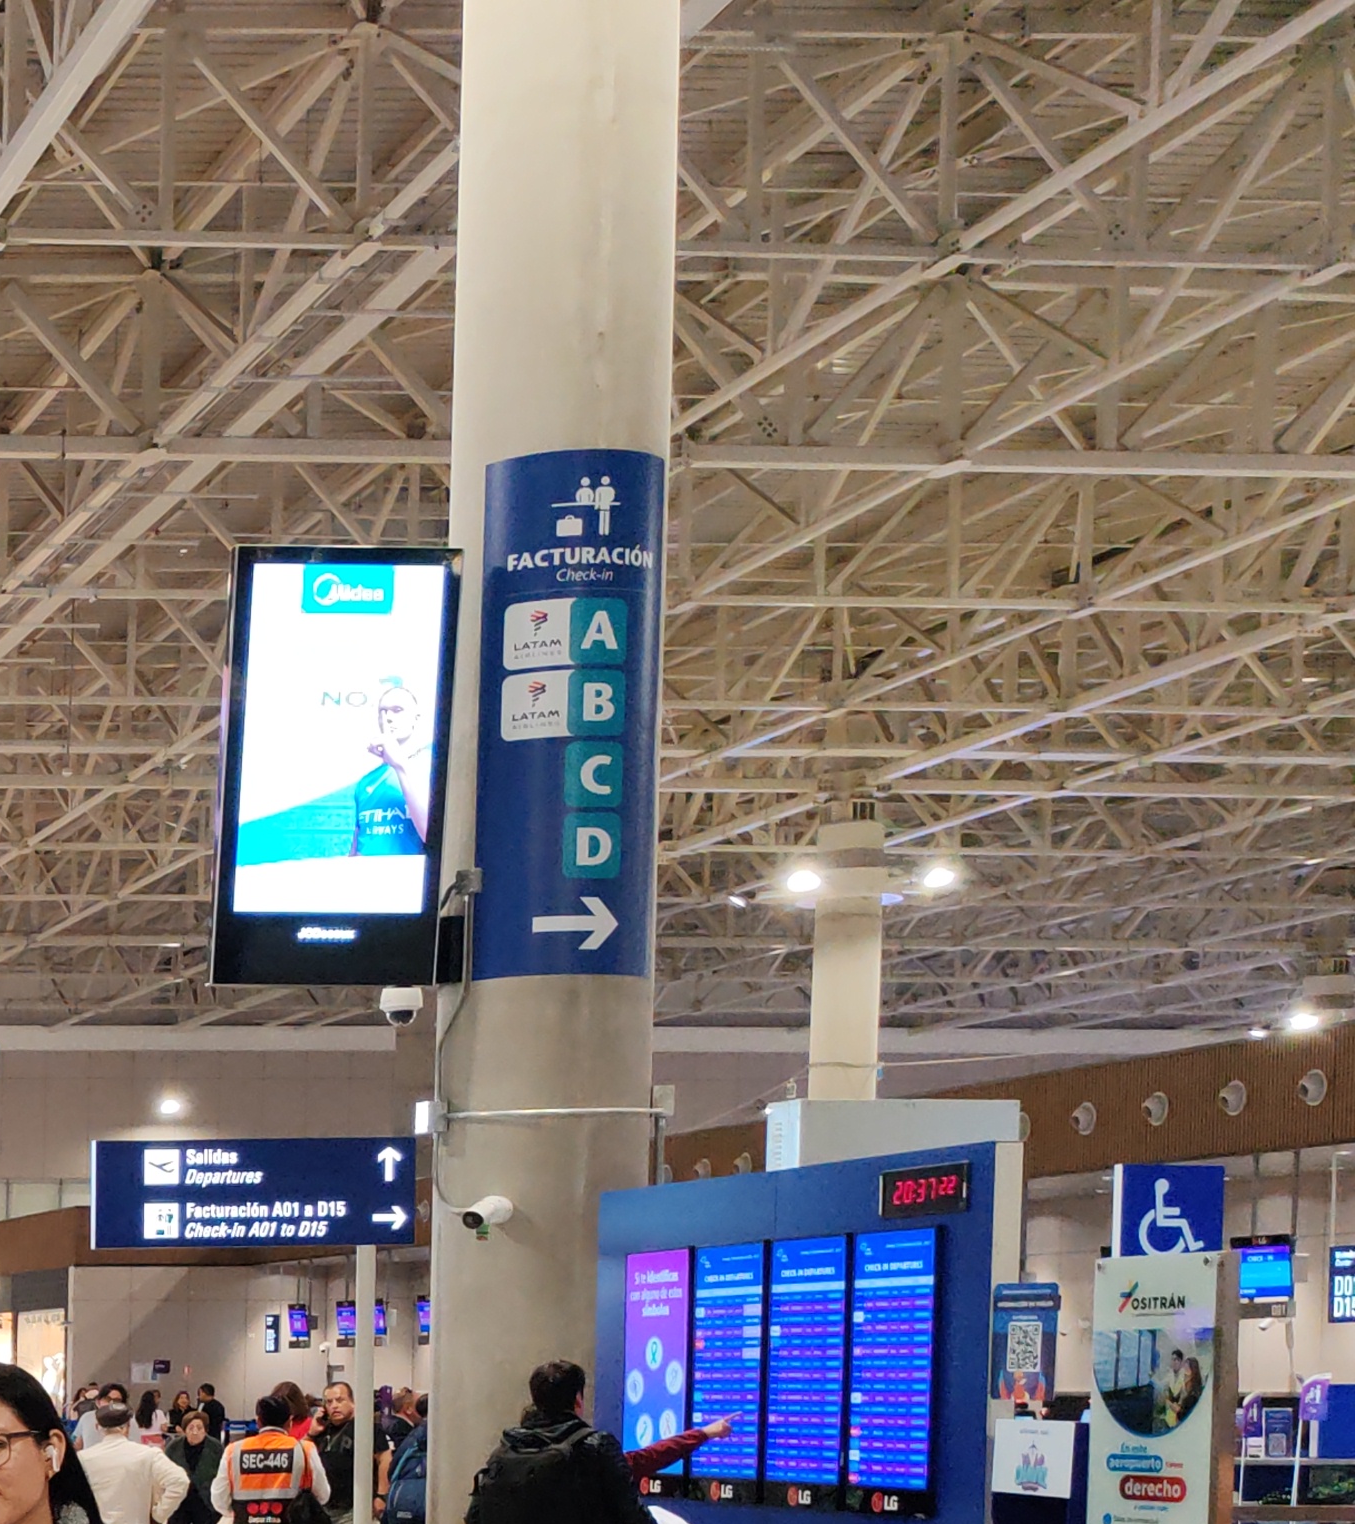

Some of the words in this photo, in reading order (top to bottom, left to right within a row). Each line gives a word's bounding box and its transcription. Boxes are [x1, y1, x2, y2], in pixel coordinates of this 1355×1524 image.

[506, 544, 654, 572] FACTURACIÓN
[555, 568, 614, 582] Check-in
[580, 610, 619, 650] A
[513, 638, 562, 652] LATAM
[582, 682, 615, 722] B
[511, 709, 560, 722] LATAM
[580, 755, 613, 795] C
[575, 827, 612, 867] D
[186, 1148, 239, 1165] Salidas
[185, 1169, 263, 1187] Departures
[186, 1202, 268, 1219] Facturación
[272, 1201, 300, 1218] A01
[304, 1205, 314, 1218] a
[318, 1201, 347, 1217] D15
[185, 1221, 246, 1239] Check-in
[248, 1222, 278, 1238] A01
[280, 1223, 296, 1238] to
[298, 1221, 328, 1238] D15
[1131, 1292, 1186, 1311] OSITRÁN
[242, 1453, 289, 1469] SEC-446
[649, 1480, 662, 1494] LG
[721, 1484, 733, 1499] LG
[1124, 1478, 1182, 1498] derecho
[798, 1489, 811, 1505] LG
[884, 1495, 898, 1511] LG
